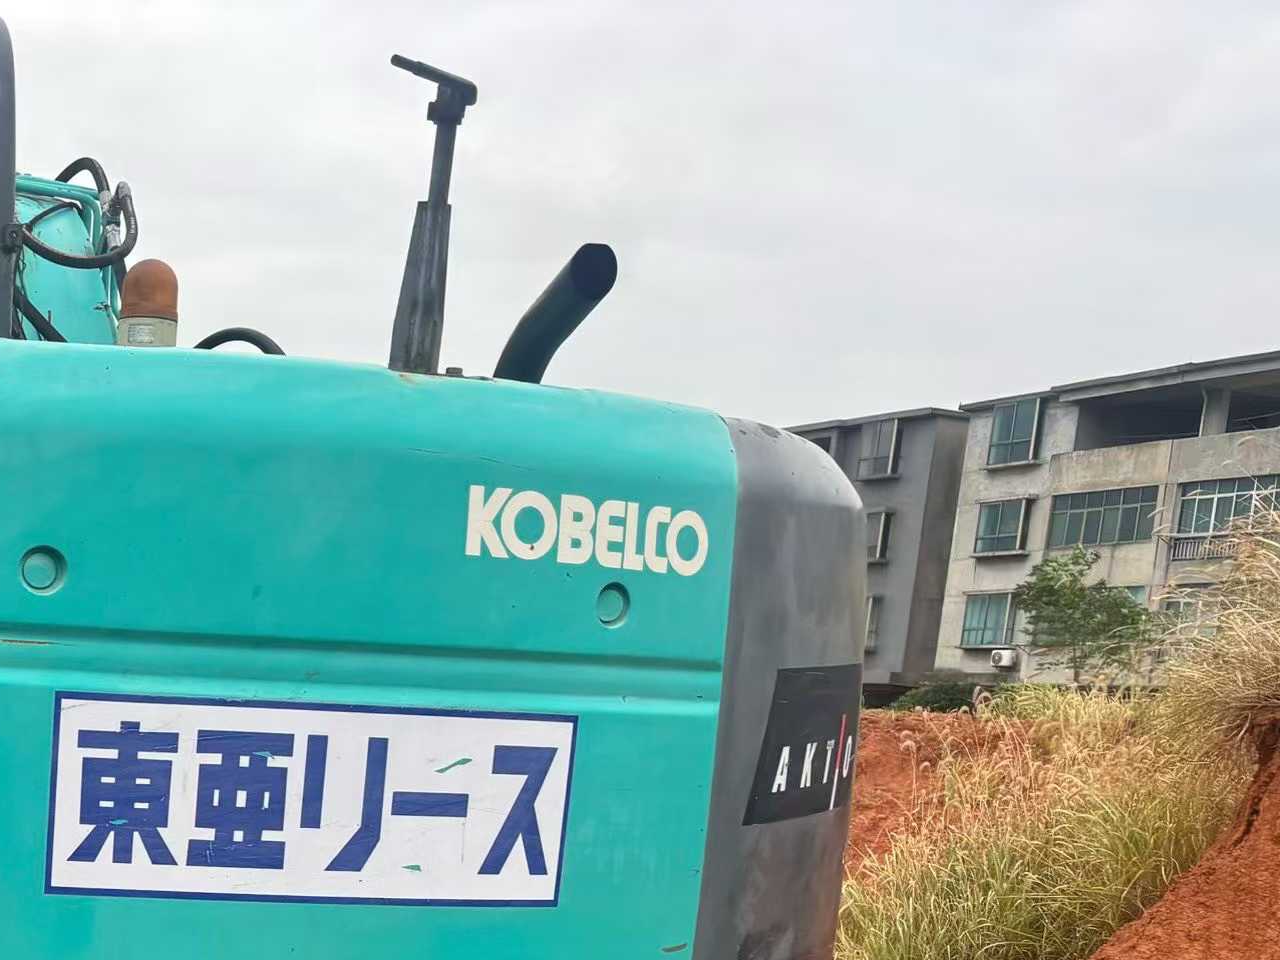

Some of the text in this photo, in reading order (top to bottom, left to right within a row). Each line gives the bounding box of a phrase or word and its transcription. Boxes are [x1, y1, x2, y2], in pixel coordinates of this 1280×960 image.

[465, 484, 708, 576] KOBELCO
[66, 720, 558, 876] 東亜リース
[771, 713, 853, 811] AKTIO
